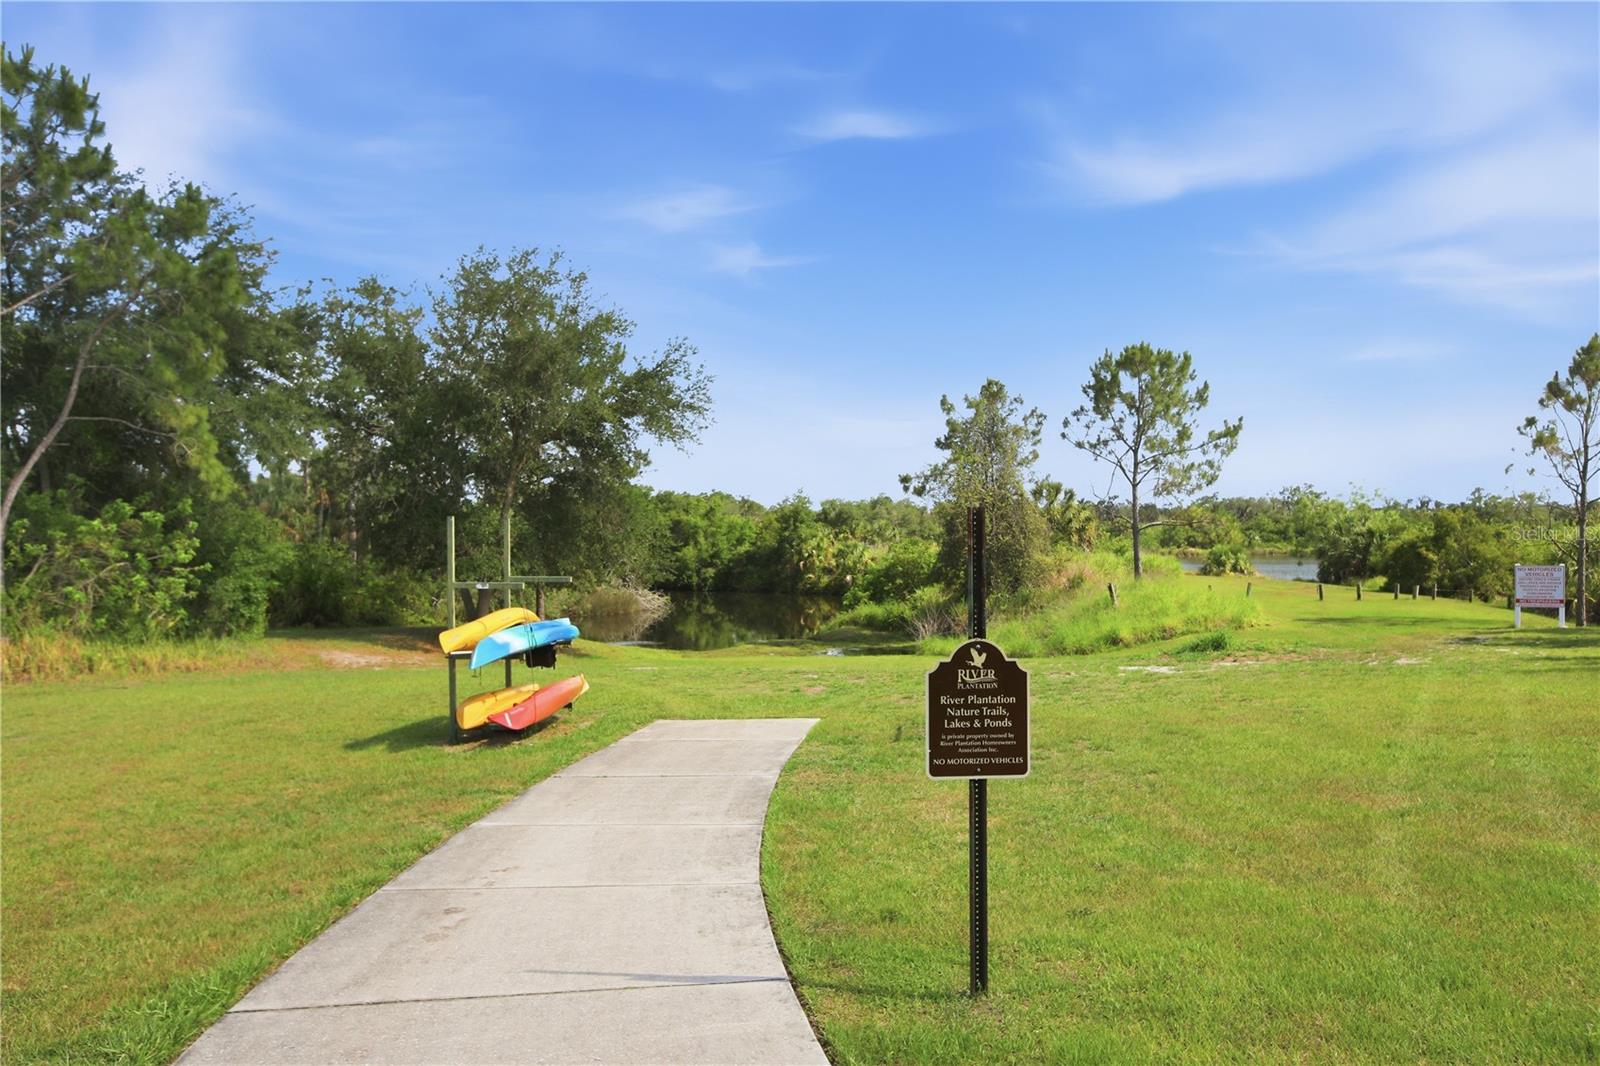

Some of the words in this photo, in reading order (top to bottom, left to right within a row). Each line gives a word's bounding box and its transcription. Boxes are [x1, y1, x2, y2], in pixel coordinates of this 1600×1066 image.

[958, 668, 998, 682] RIVER
[940, 694, 965, 705] River
[967, 694, 1016, 704] Plantation
[946, 707, 980, 716] Nature
[982, 706, 1010, 717] Trails,
[944, 718, 971, 728] Lakes
[973, 719, 981, 728] &
[984, 717, 1012, 727] Ponds
[946, 757, 990, 765] MOTORIZED
